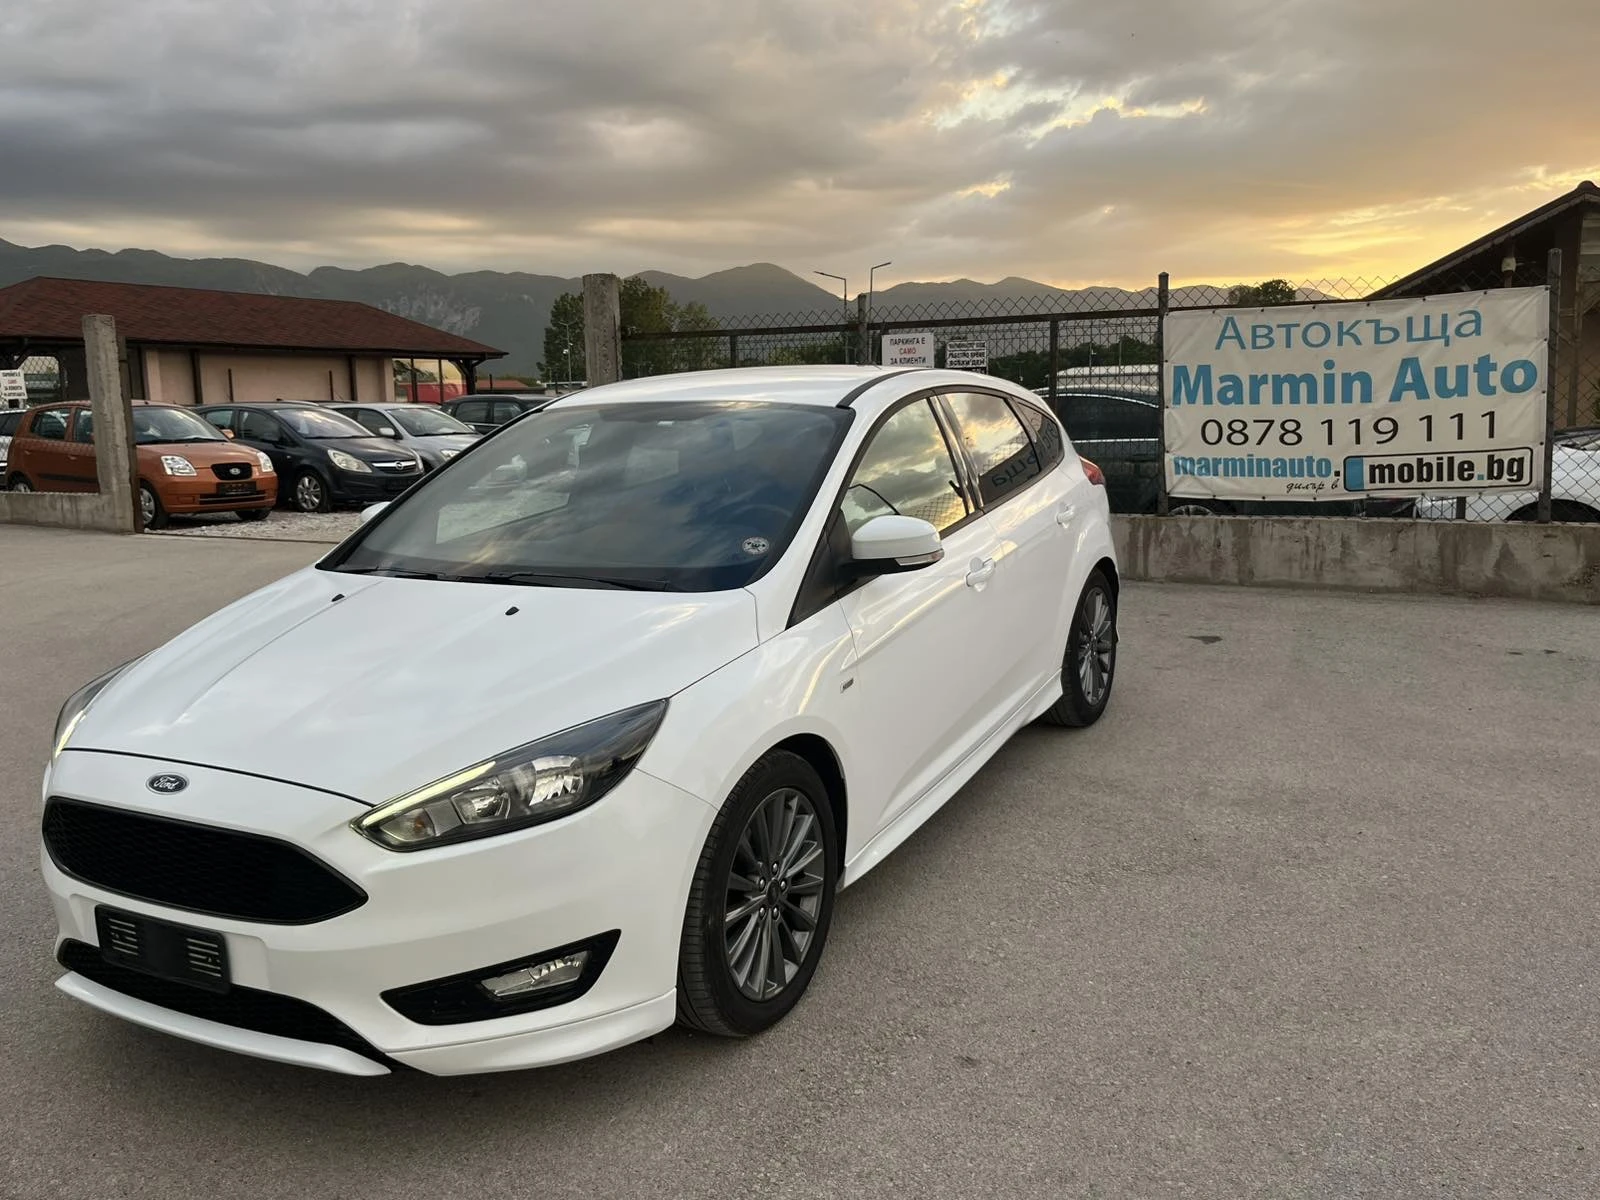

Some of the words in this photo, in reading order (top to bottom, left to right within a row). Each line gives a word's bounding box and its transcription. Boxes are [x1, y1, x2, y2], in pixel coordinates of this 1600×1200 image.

[1215, 309, 1482, 350] Автокъща
[890, 357, 898, 365] ЗА
[899, 356, 926, 364] КЛИЕНТИ
[899, 347, 916, 355] САМО
[1172, 359, 1373, 406] Marmin
[1388, 353, 1538, 402] Auto
[1201, 419, 1303, 446] 0878
[1320, 417, 1399, 446] 119
[1418, 411, 1496, 442] 111
[1368, 454, 1525, 483] mobile.bg
[153, 775, 180, 790] Ford
